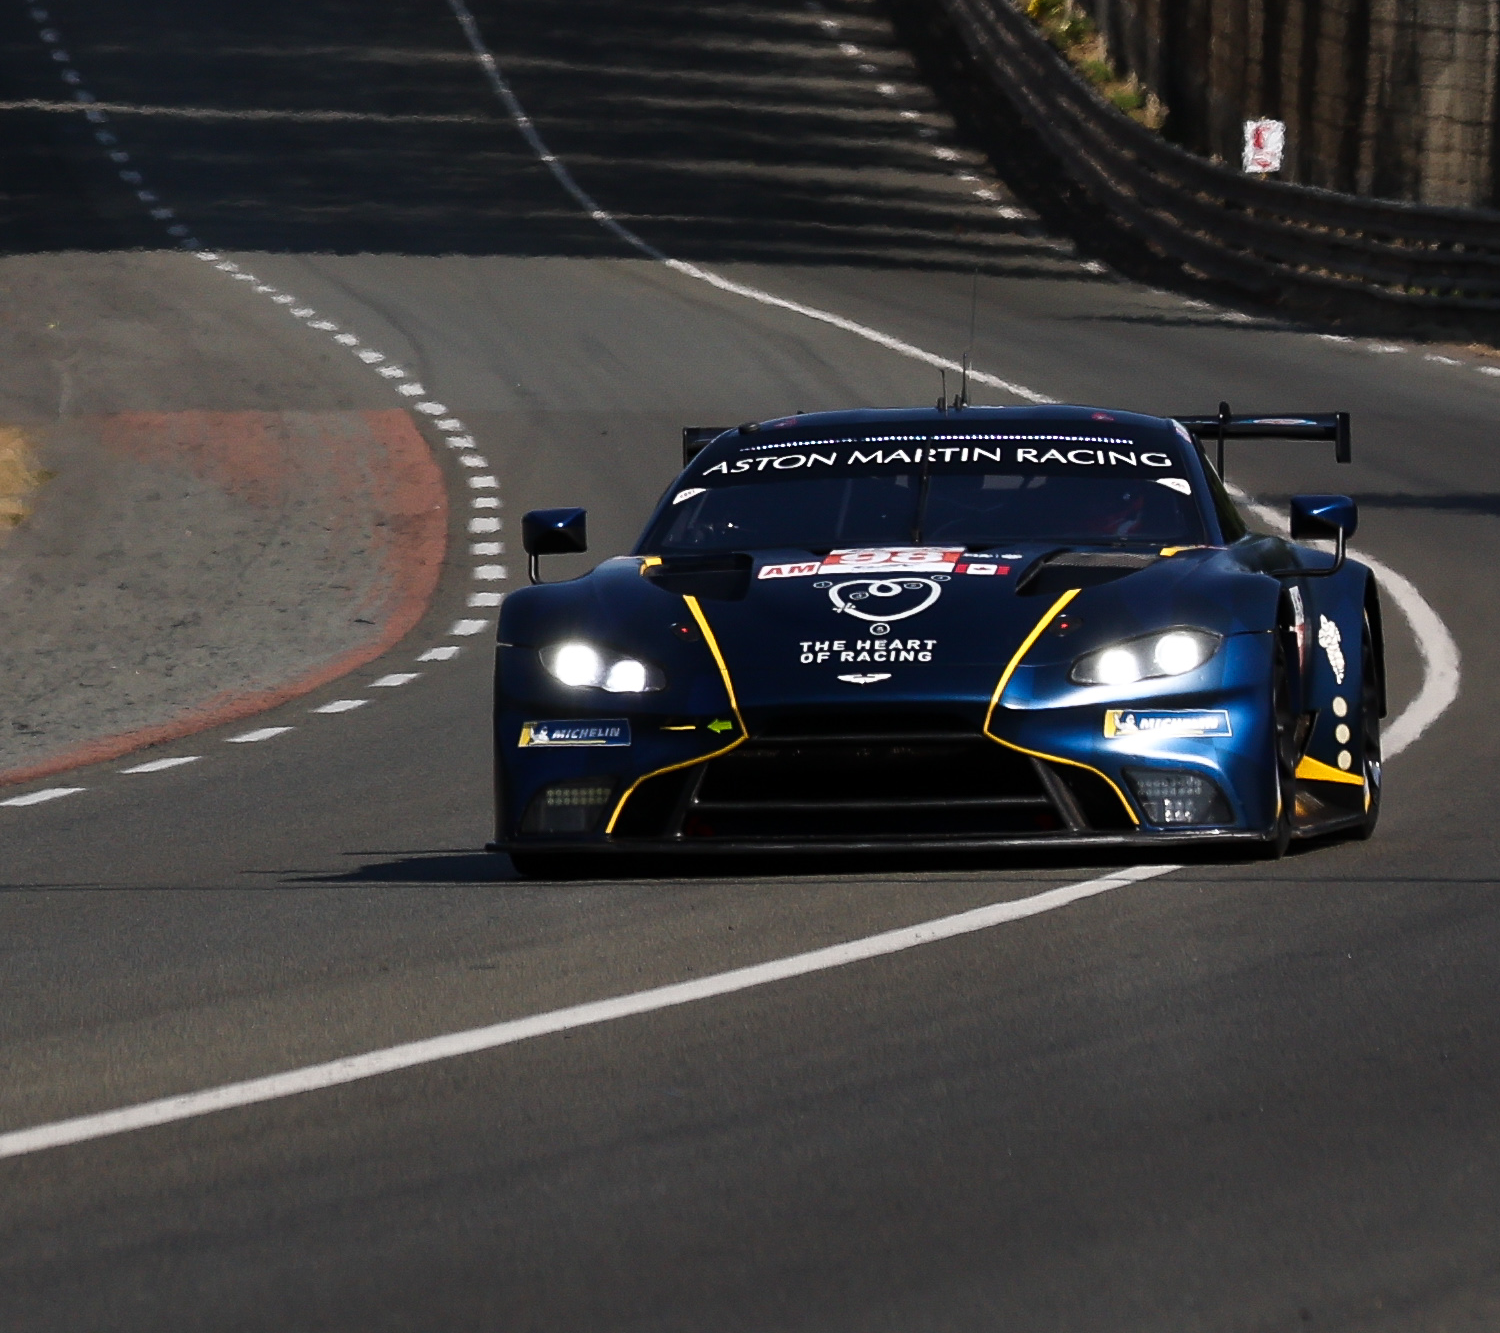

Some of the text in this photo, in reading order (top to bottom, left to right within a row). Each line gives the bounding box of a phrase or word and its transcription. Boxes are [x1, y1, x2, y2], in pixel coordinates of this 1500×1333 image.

[702, 446, 1173, 477] ASTON MARTIN RACING
[839, 551, 944, 565] 98
[765, 564, 816, 577] AM
[800, 638, 938, 652] THE HEART
[800, 650, 933, 663] OF RACING
[551, 727, 620, 739] MICHELIN
